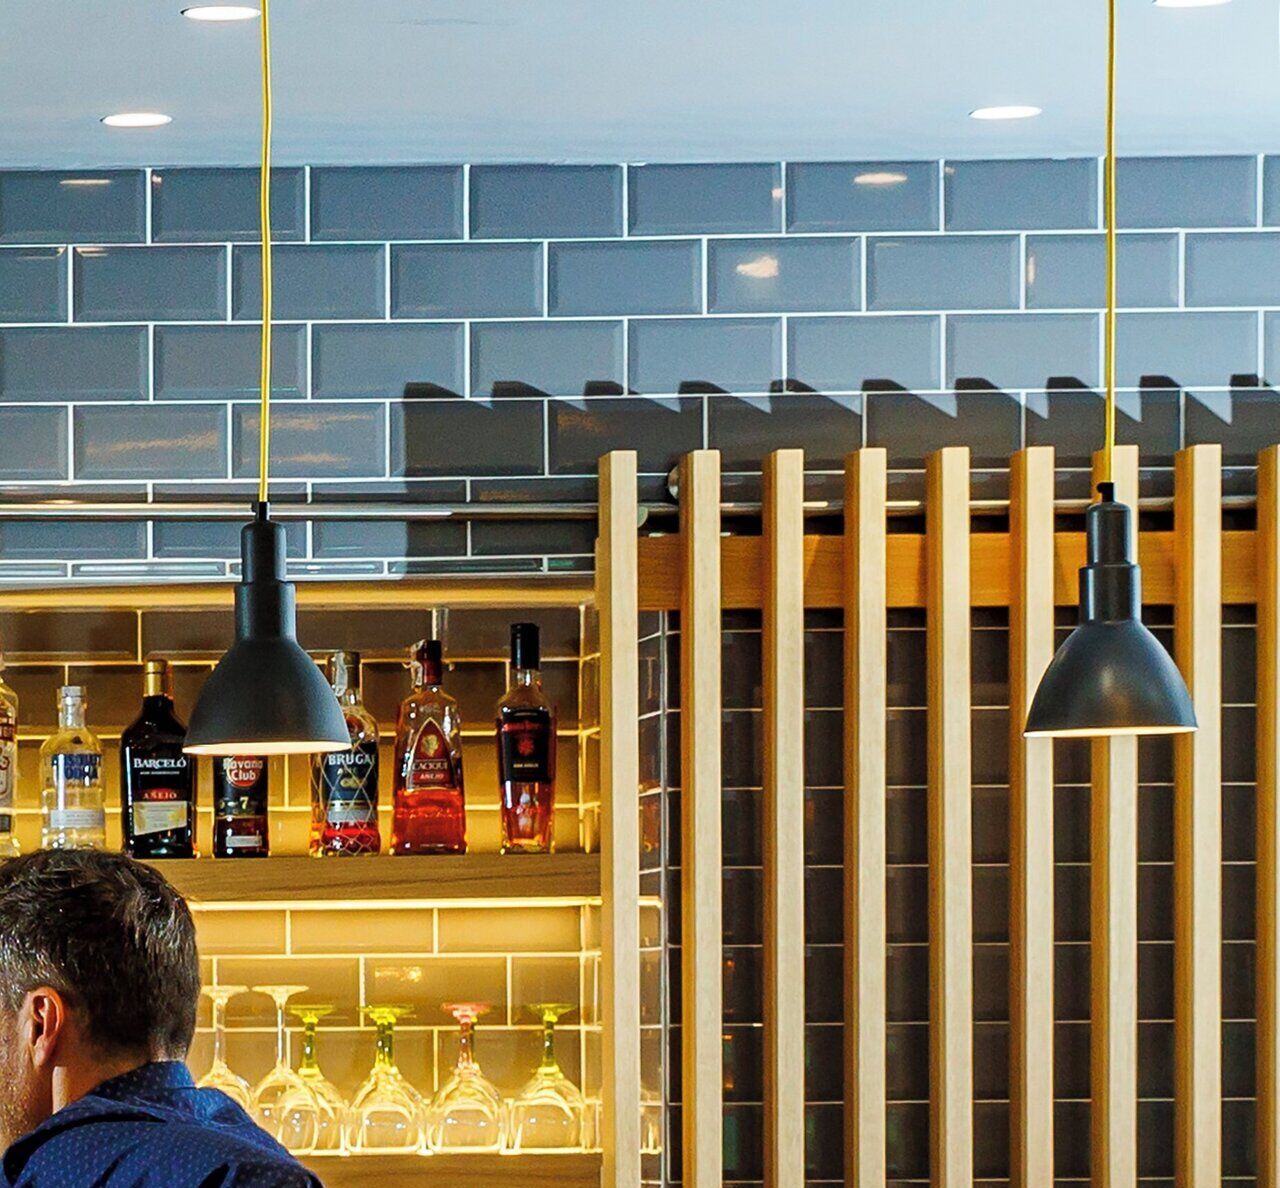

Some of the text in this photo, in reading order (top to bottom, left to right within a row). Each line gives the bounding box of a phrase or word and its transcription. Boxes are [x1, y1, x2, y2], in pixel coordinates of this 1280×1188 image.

[133, 757, 186, 769] BARCELÓ
[231, 770, 256, 780] Club
[240, 796, 248, 809] 7
